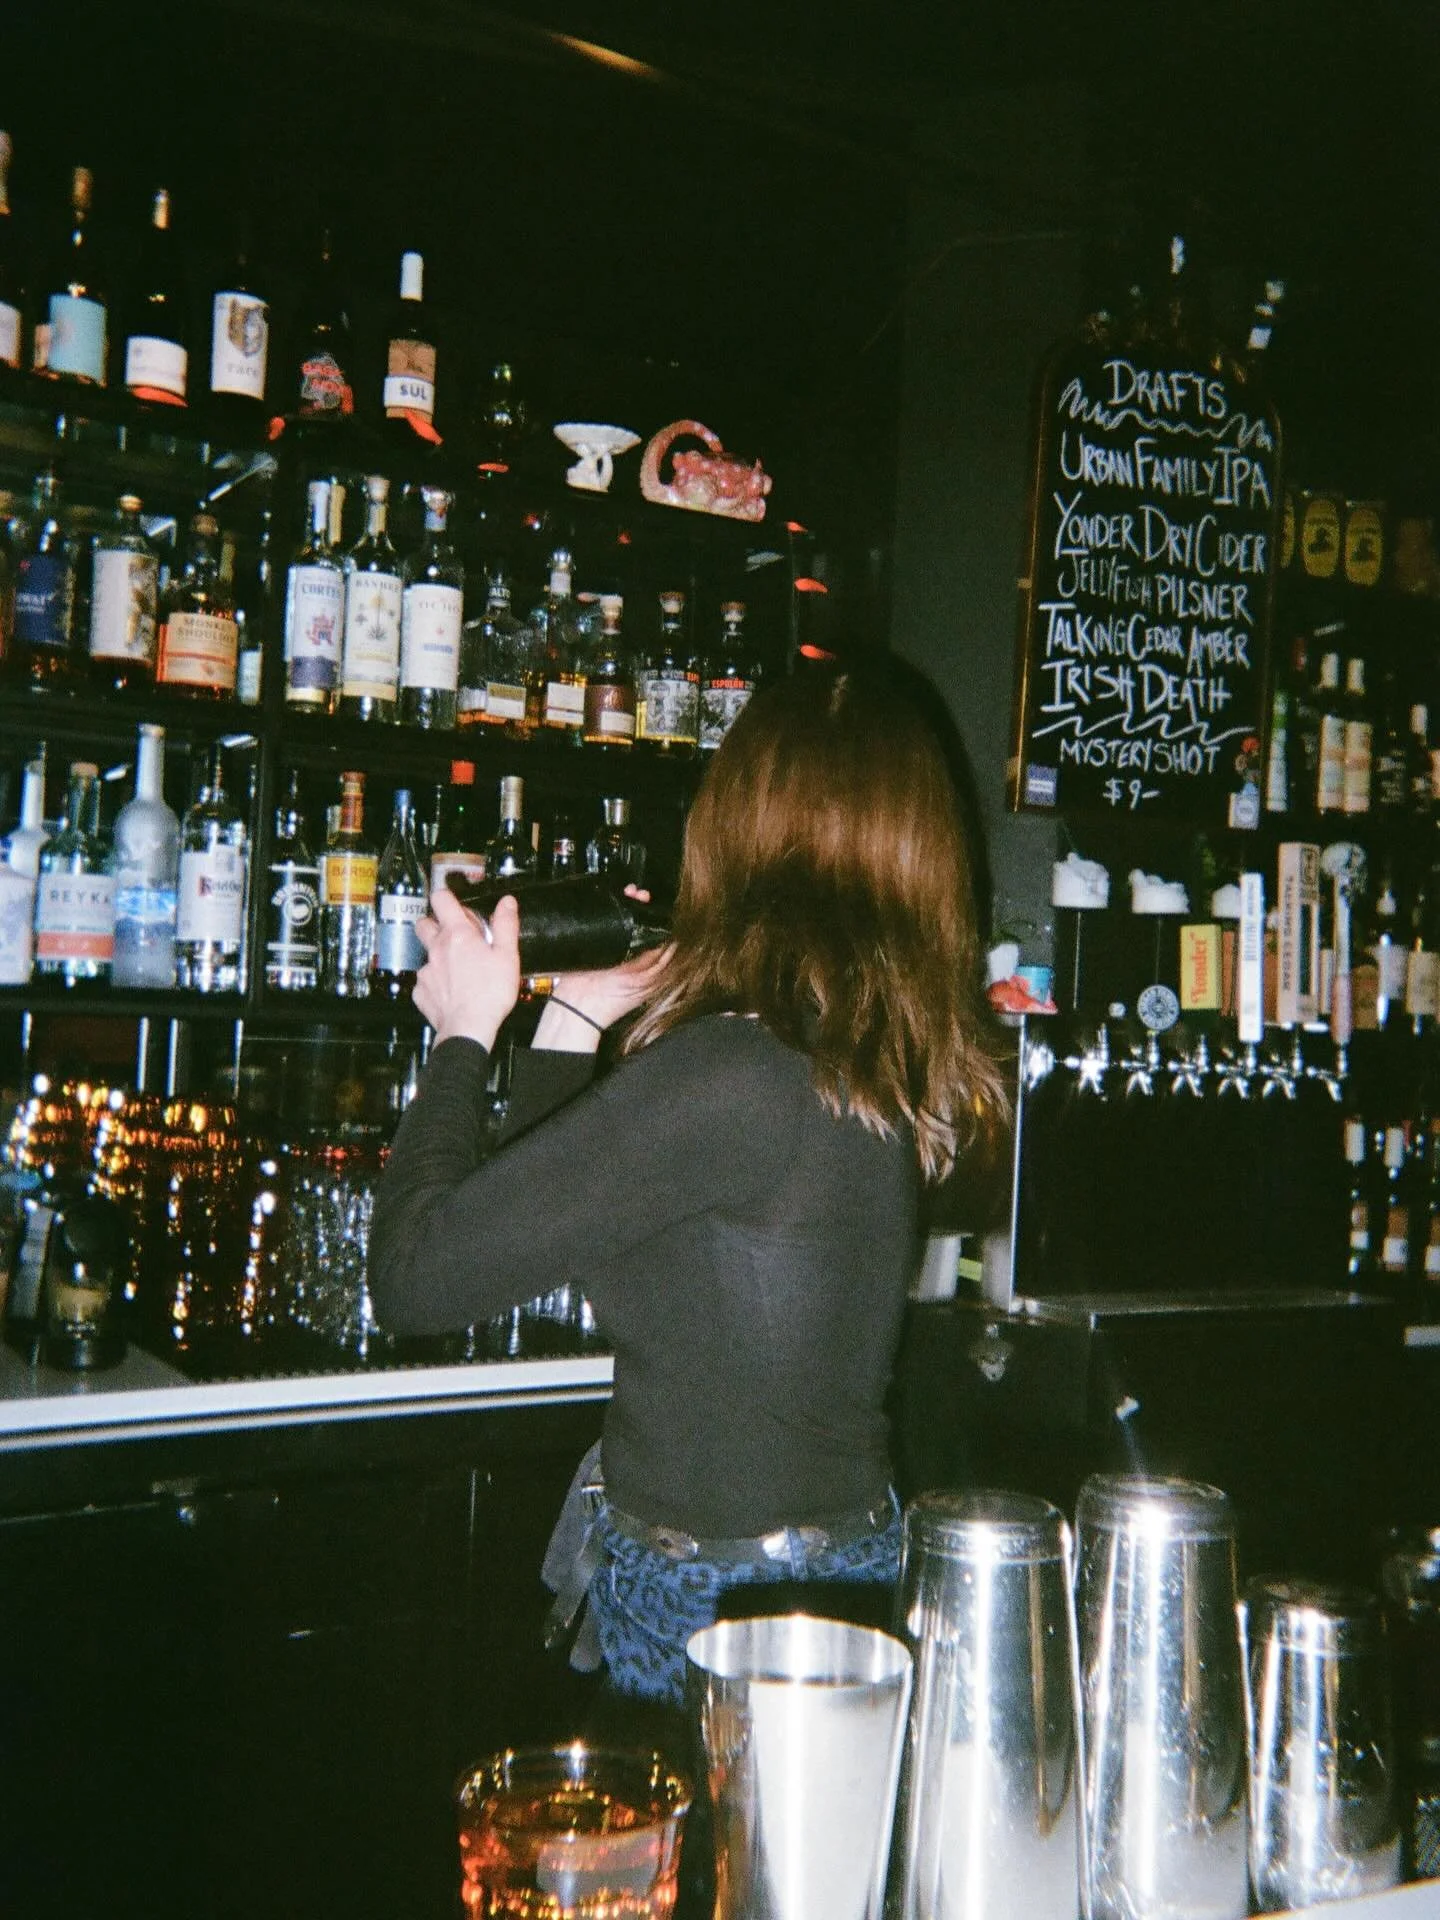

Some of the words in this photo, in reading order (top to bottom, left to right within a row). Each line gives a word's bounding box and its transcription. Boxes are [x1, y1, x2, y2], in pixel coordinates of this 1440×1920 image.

[400, 383, 428, 401] SUL
[1102, 359, 1227, 419] DRAFTS
[1060, 431, 1134, 488] URBAN
[1134, 436, 1218, 498] FAMILY
[1212, 446, 1272, 511] IPA
[1053, 491, 1141, 561] YONDER
[1139, 504, 1195, 569] DRY
[1195, 514, 1267, 578] CIDER
[1154, 573, 1254, 626] PILSNER
[1038, 602, 1127, 657] TALKING
[1126, 613, 1185, 661] CEDAR
[1186, 625, 1251, 682] AMBER
[1040, 659, 1136, 713] IRISH
[1137, 664, 1232, 717] DEATH
[1060, 738, 1152, 772] MYSTERY
[1154, 742, 1221, 775] SHOT
